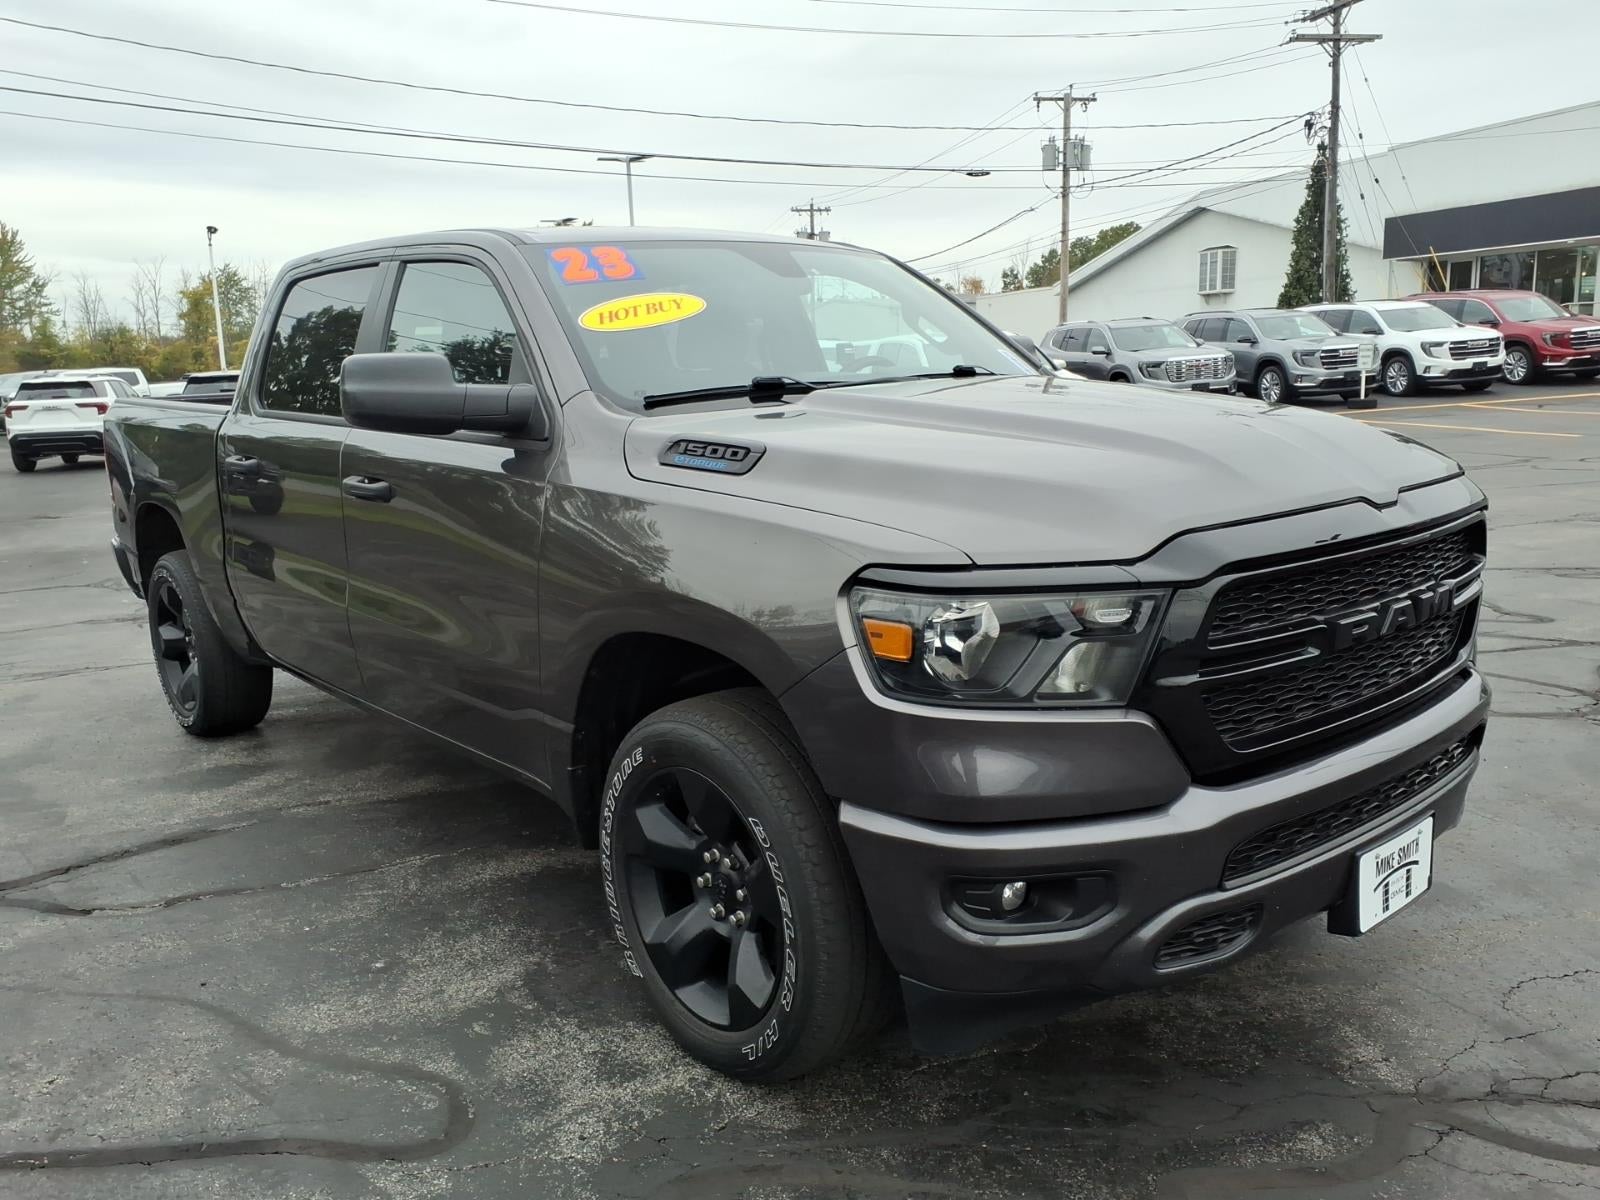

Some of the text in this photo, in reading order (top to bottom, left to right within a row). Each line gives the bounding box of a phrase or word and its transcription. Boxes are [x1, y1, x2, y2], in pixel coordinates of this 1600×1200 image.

[551, 245, 636, 283] 23
[598, 297, 685, 326] HOT BUY
[671, 441, 747, 462] 1500
[1325, 584, 1452, 651] RAM
[1375, 837, 1420, 877] MIKE SMITH
[748, 816, 796, 1012] DUELER
